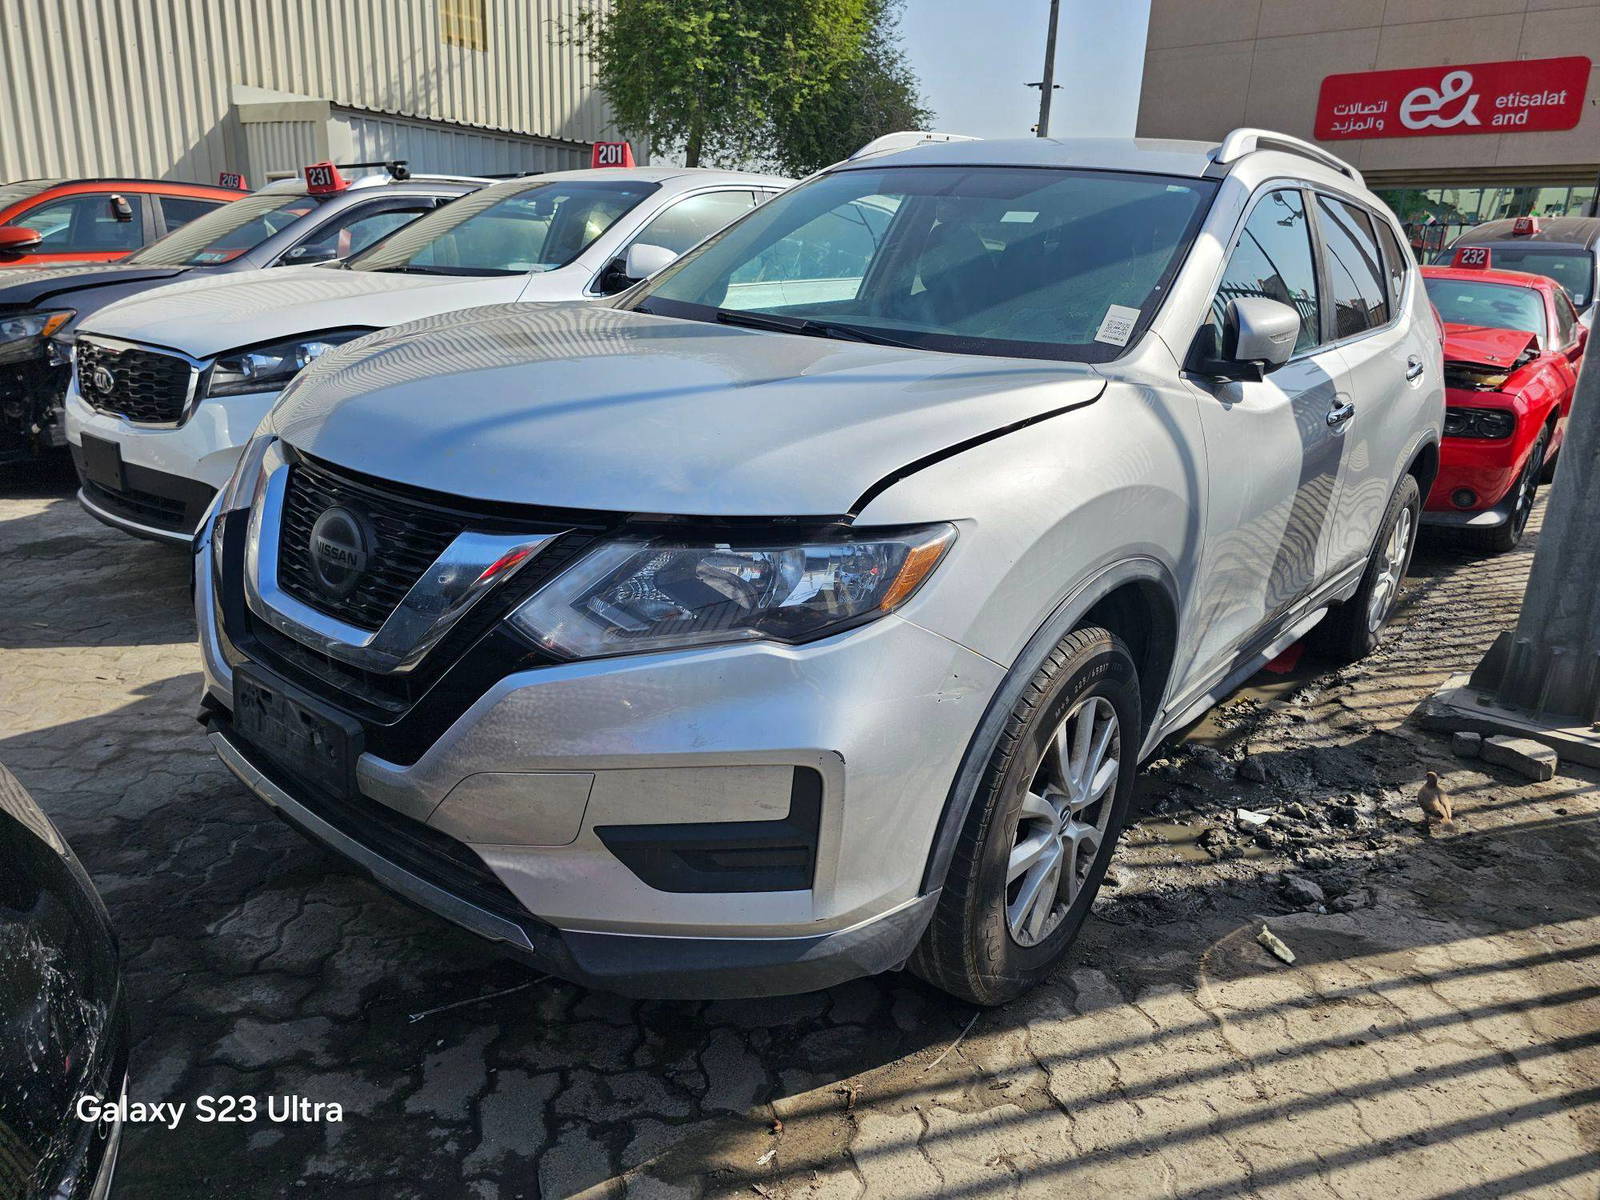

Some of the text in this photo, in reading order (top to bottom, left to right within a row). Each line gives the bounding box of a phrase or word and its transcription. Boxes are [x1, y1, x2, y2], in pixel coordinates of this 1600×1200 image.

[1400, 70, 1482, 130] e&
[1495, 90, 1567, 108] etisalat
[1333, 101, 1387, 116] اتصالات
[1491, 109, 1528, 126] and
[598, 144, 622, 164] 201
[222, 174, 239, 187] 203
[309, 167, 331, 186] 231
[1461, 249, 1486, 264] 232
[317, 540, 358, 567] NISSAN
